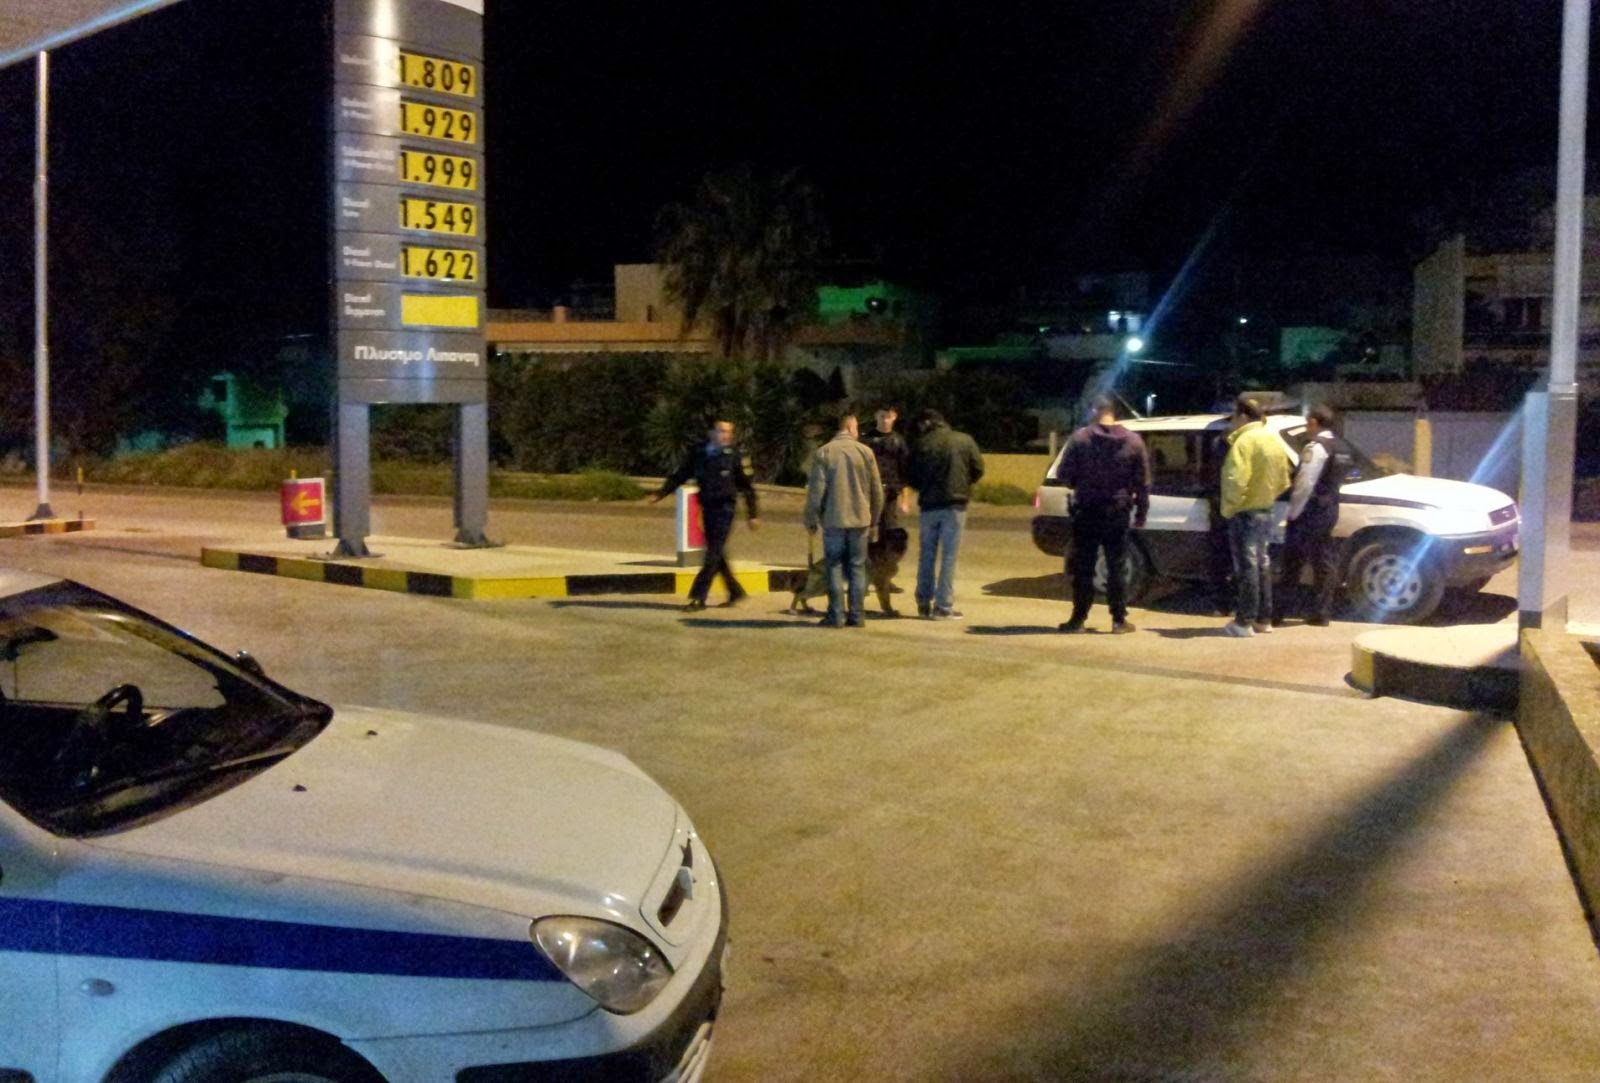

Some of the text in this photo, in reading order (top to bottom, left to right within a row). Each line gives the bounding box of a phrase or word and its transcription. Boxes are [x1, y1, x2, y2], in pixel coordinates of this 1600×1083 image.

[400, 55, 471, 94] 1.809
[400, 103, 472, 141] 1.929
[401, 152, 472, 188] 1.999
[401, 200, 473, 233] 1.549
[401, 248, 473, 280] 1.622
